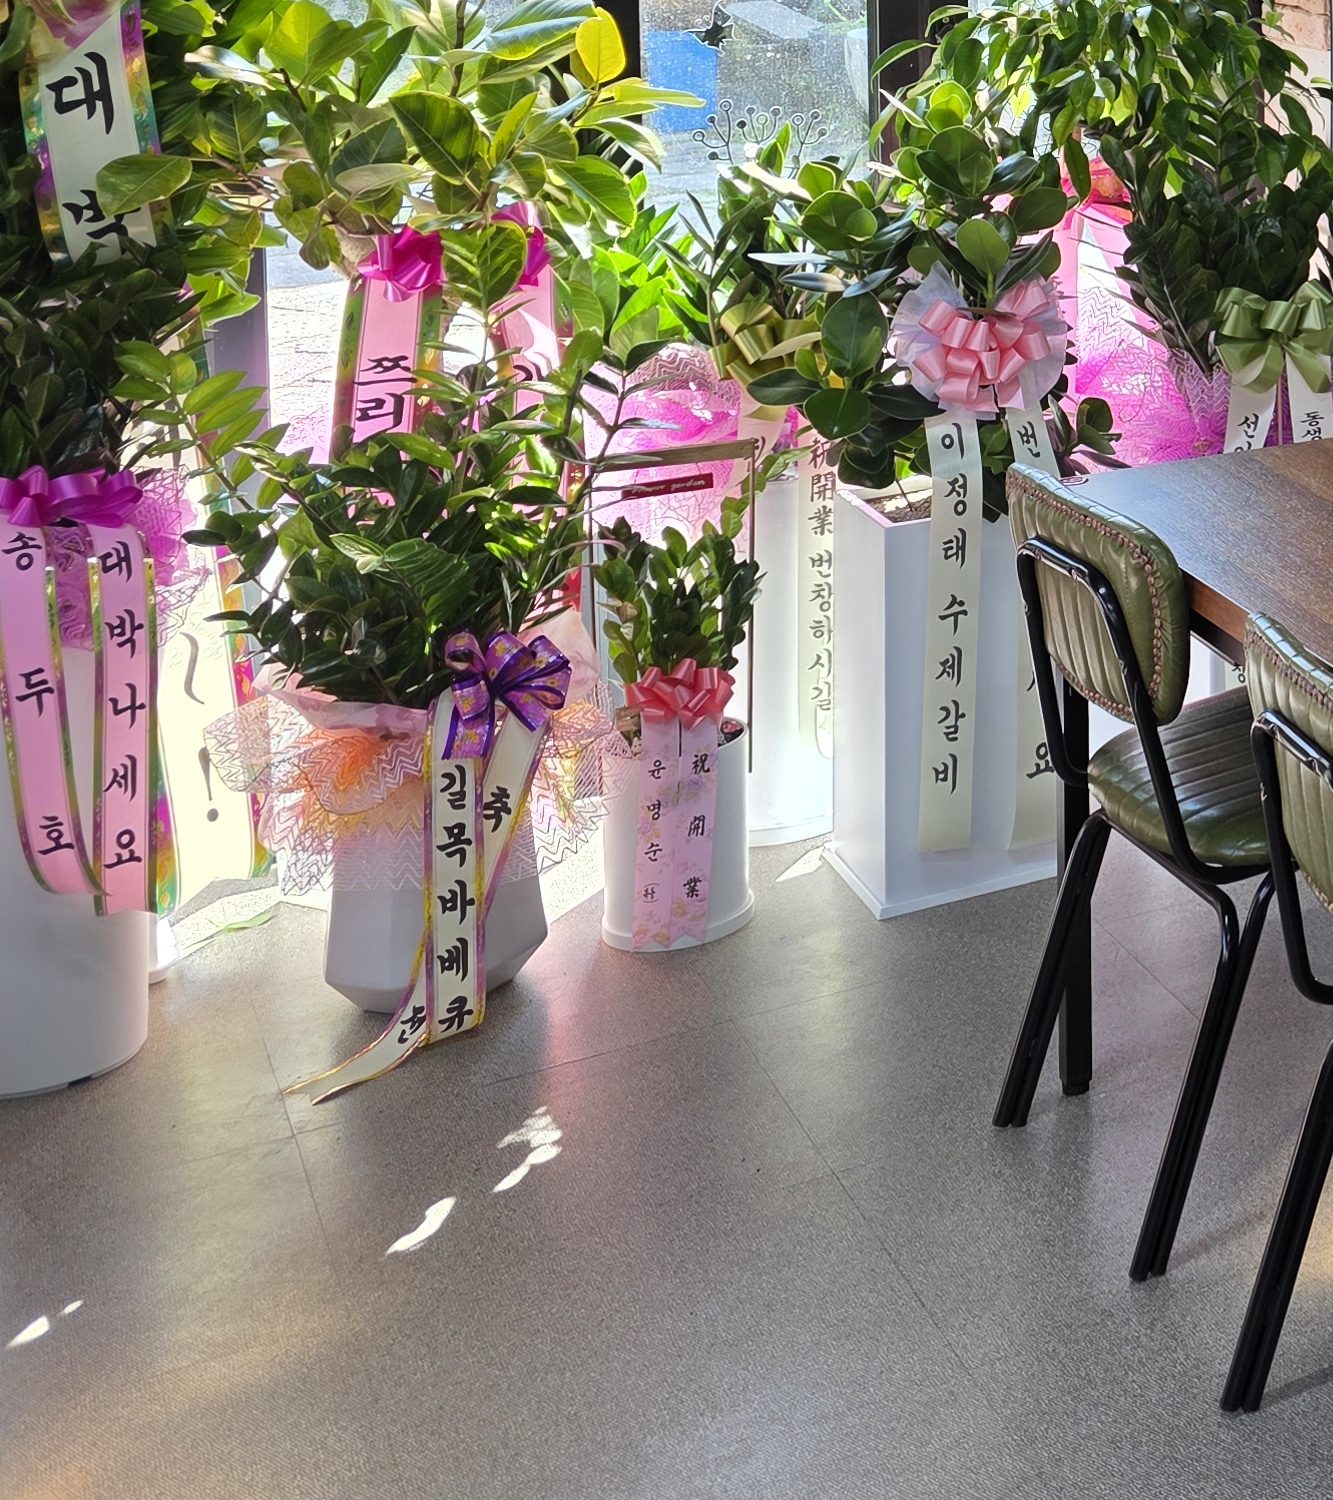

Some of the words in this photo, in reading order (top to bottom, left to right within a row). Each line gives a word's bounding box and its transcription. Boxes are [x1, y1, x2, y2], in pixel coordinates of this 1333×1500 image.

[940, 422, 968, 569] 이정태
[98, 540, 146, 869] 대박나세요
[933, 594, 969, 795] 수제갈비
[436, 766, 475, 1032] 길목바베큐
